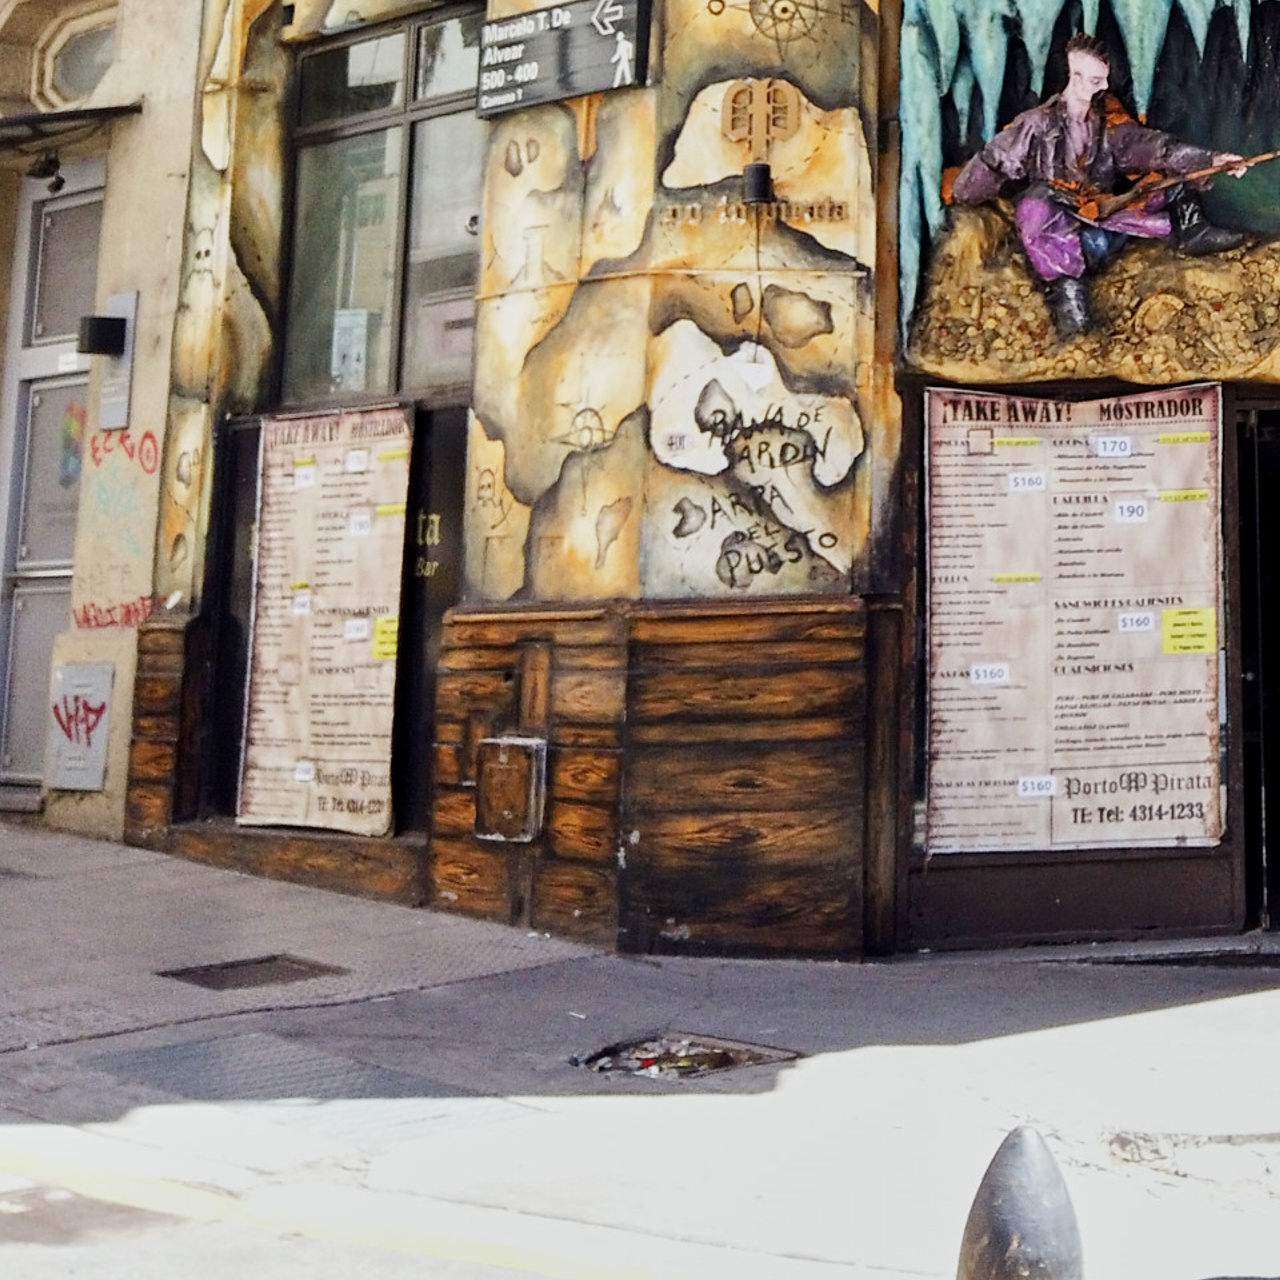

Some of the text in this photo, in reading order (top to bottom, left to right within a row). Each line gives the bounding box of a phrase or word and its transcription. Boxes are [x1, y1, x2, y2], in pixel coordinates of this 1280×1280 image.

[483, 8, 571, 44] Marcelo T. De
[483, 43, 525, 67] Alvear
[482, 70, 504, 92] 500
[515, 62, 539, 82] 400
[797, 406, 825, 429] DE
[1007, 401, 1073, 423] AWAY!
[1101, 439, 1128, 453] 170
[1012, 476, 1043, 488] $160
[1118, 505, 1145, 518] 190
[1121, 616, 1150, 628] $160
[974, 667, 1005, 681] $160
[1021, 780, 1053, 792] $160
[1064, 773, 1213, 799] Porto Pirata
[1098, 806, 1124, 823] Tel:
[1129, 802, 1205, 822] 4314-1233
